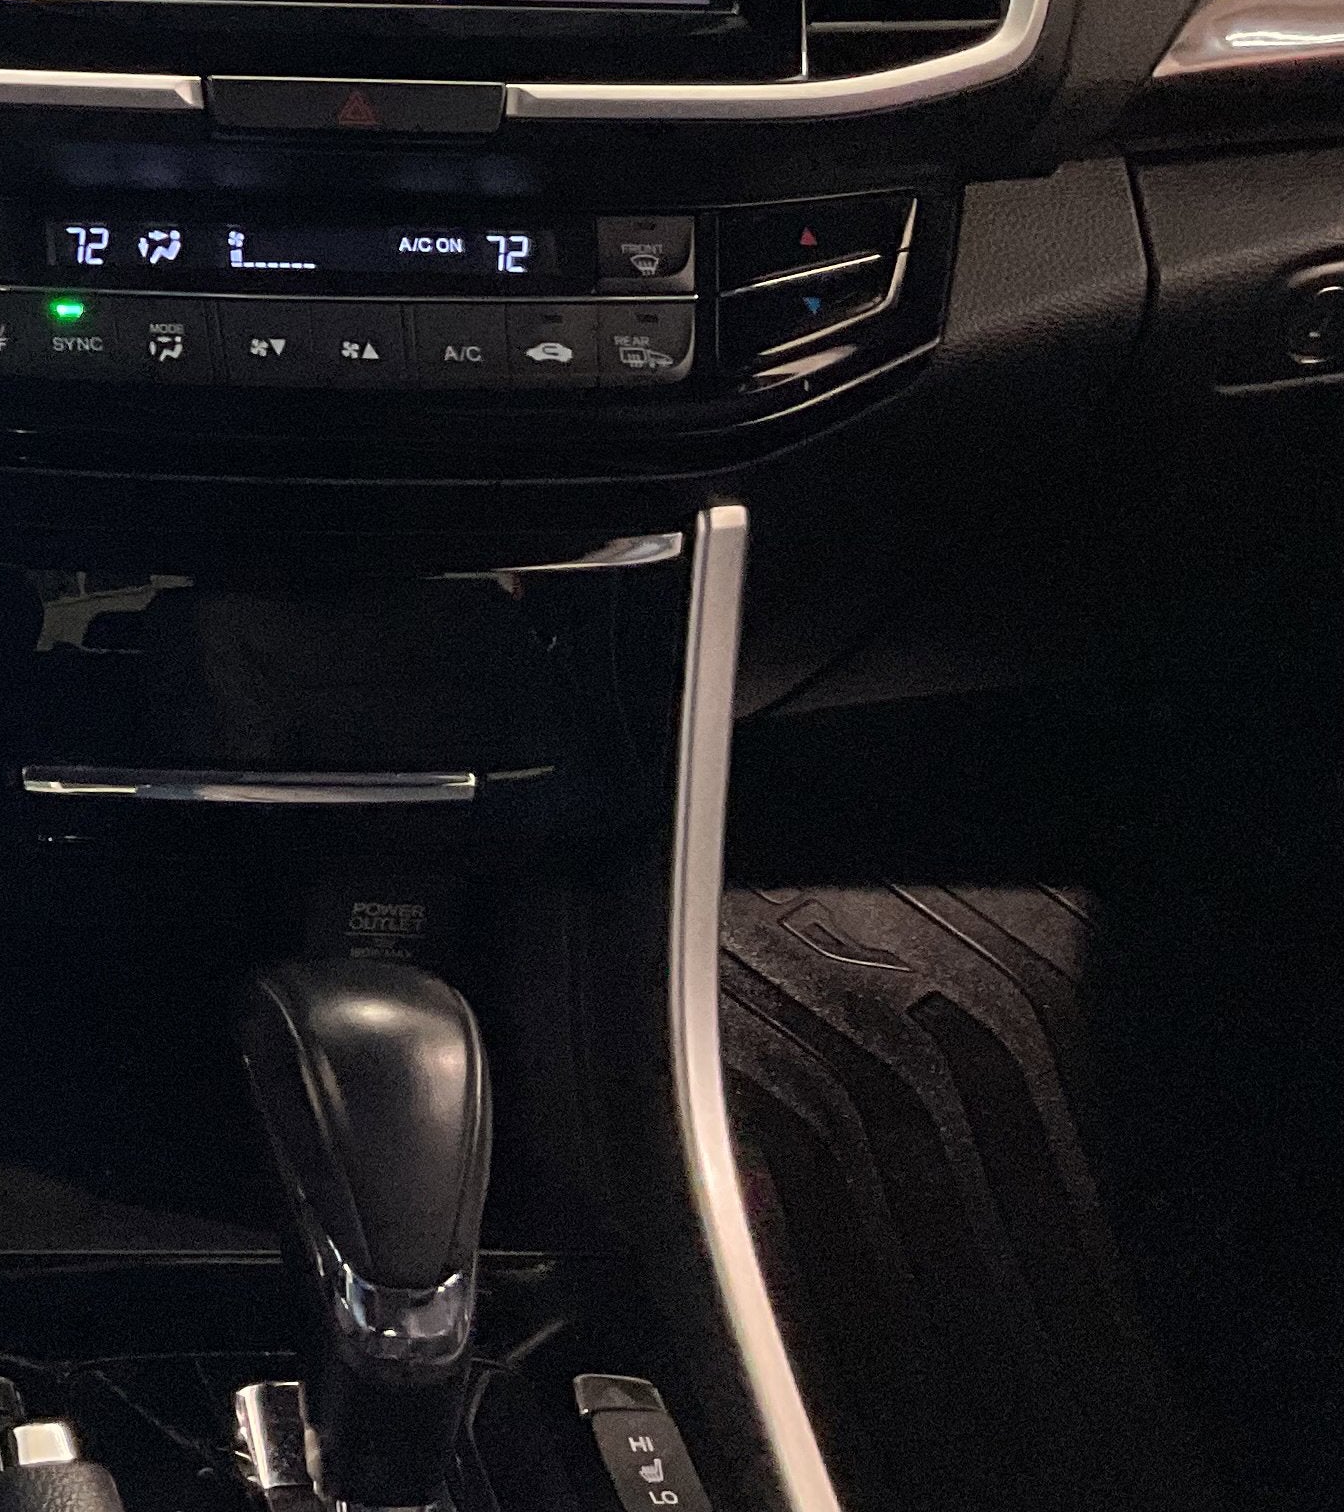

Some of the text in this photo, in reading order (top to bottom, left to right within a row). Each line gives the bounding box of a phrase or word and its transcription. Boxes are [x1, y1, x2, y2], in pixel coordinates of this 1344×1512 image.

[66, 227, 109, 265] 72
[399, 237, 464, 253] A/C ON
[621, 244, 662, 255] FRONT
[486, 236, 529, 273] 72
[150, 324, 184, 334] MODE
[52, 338, 103, 352] SYNC
[614, 336, 649, 347] REAR
[444, 346, 482, 362] A/C
[352, 902, 425, 917] POWER
[628, 1436, 654, 1452] HI
[648, 1490, 678, 1505] LO
